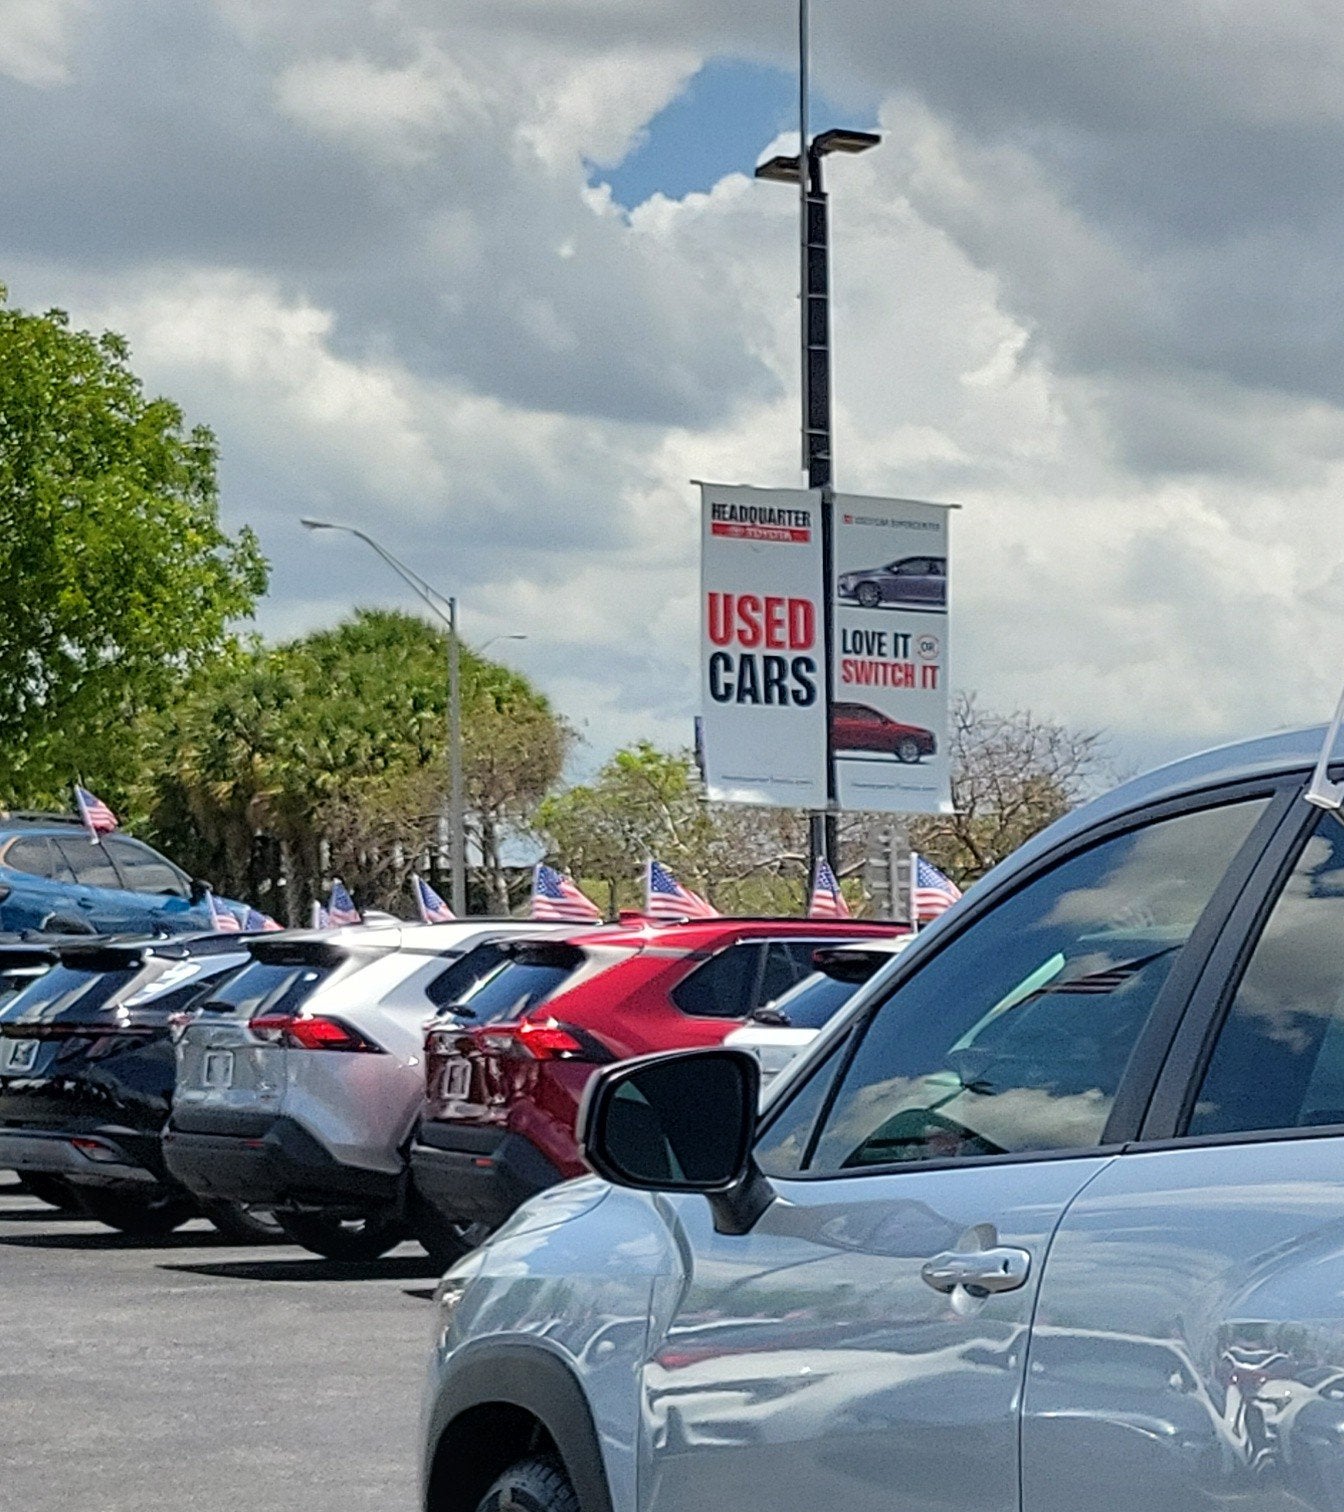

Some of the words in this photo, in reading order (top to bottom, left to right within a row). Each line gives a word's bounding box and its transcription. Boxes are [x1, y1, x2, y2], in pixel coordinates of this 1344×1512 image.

[711, 502, 811, 527] HEADQUARTER
[707, 592, 817, 650] USED
[842, 628, 887, 657] LOVE
[894, 632, 911, 658] IT
[709, 651, 817, 707] CARS
[842, 659, 915, 688] SWITCH
[922, 665, 939, 690] IT
